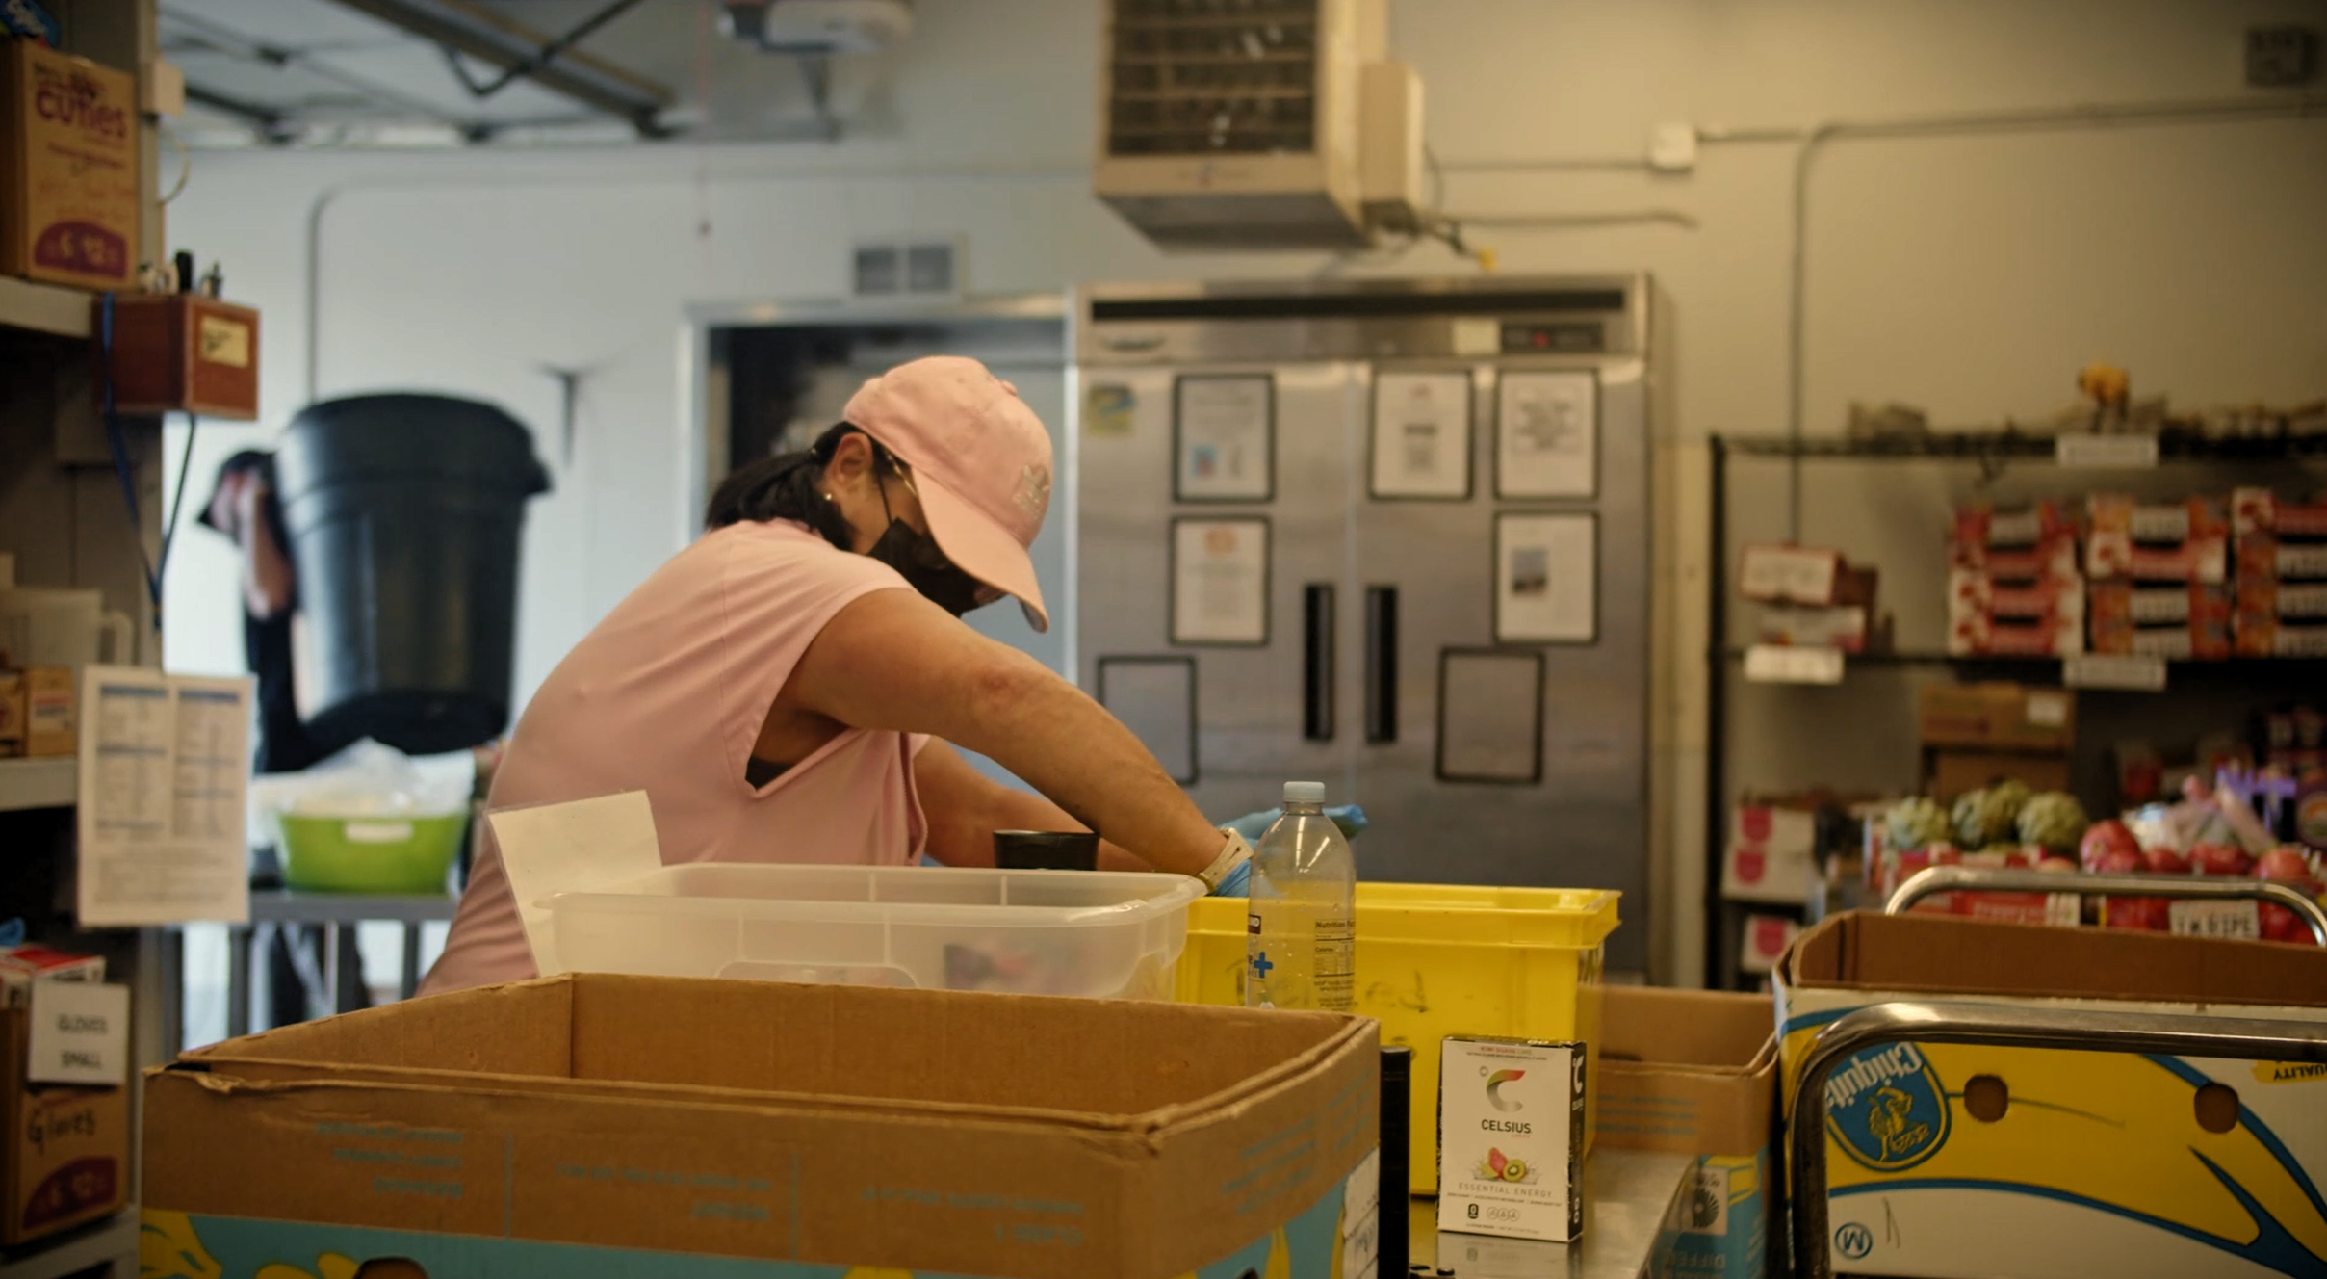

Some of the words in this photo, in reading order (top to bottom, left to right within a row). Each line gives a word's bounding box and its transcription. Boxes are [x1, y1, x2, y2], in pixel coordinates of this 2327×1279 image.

[2273, 1064, 2327, 1081] UALITY
[1481, 1118, 1532, 1134] CELSIUS
[1459, 1182, 1511, 1194] ESSENTIAL
[1514, 1186, 1553, 1198] ENERGY
